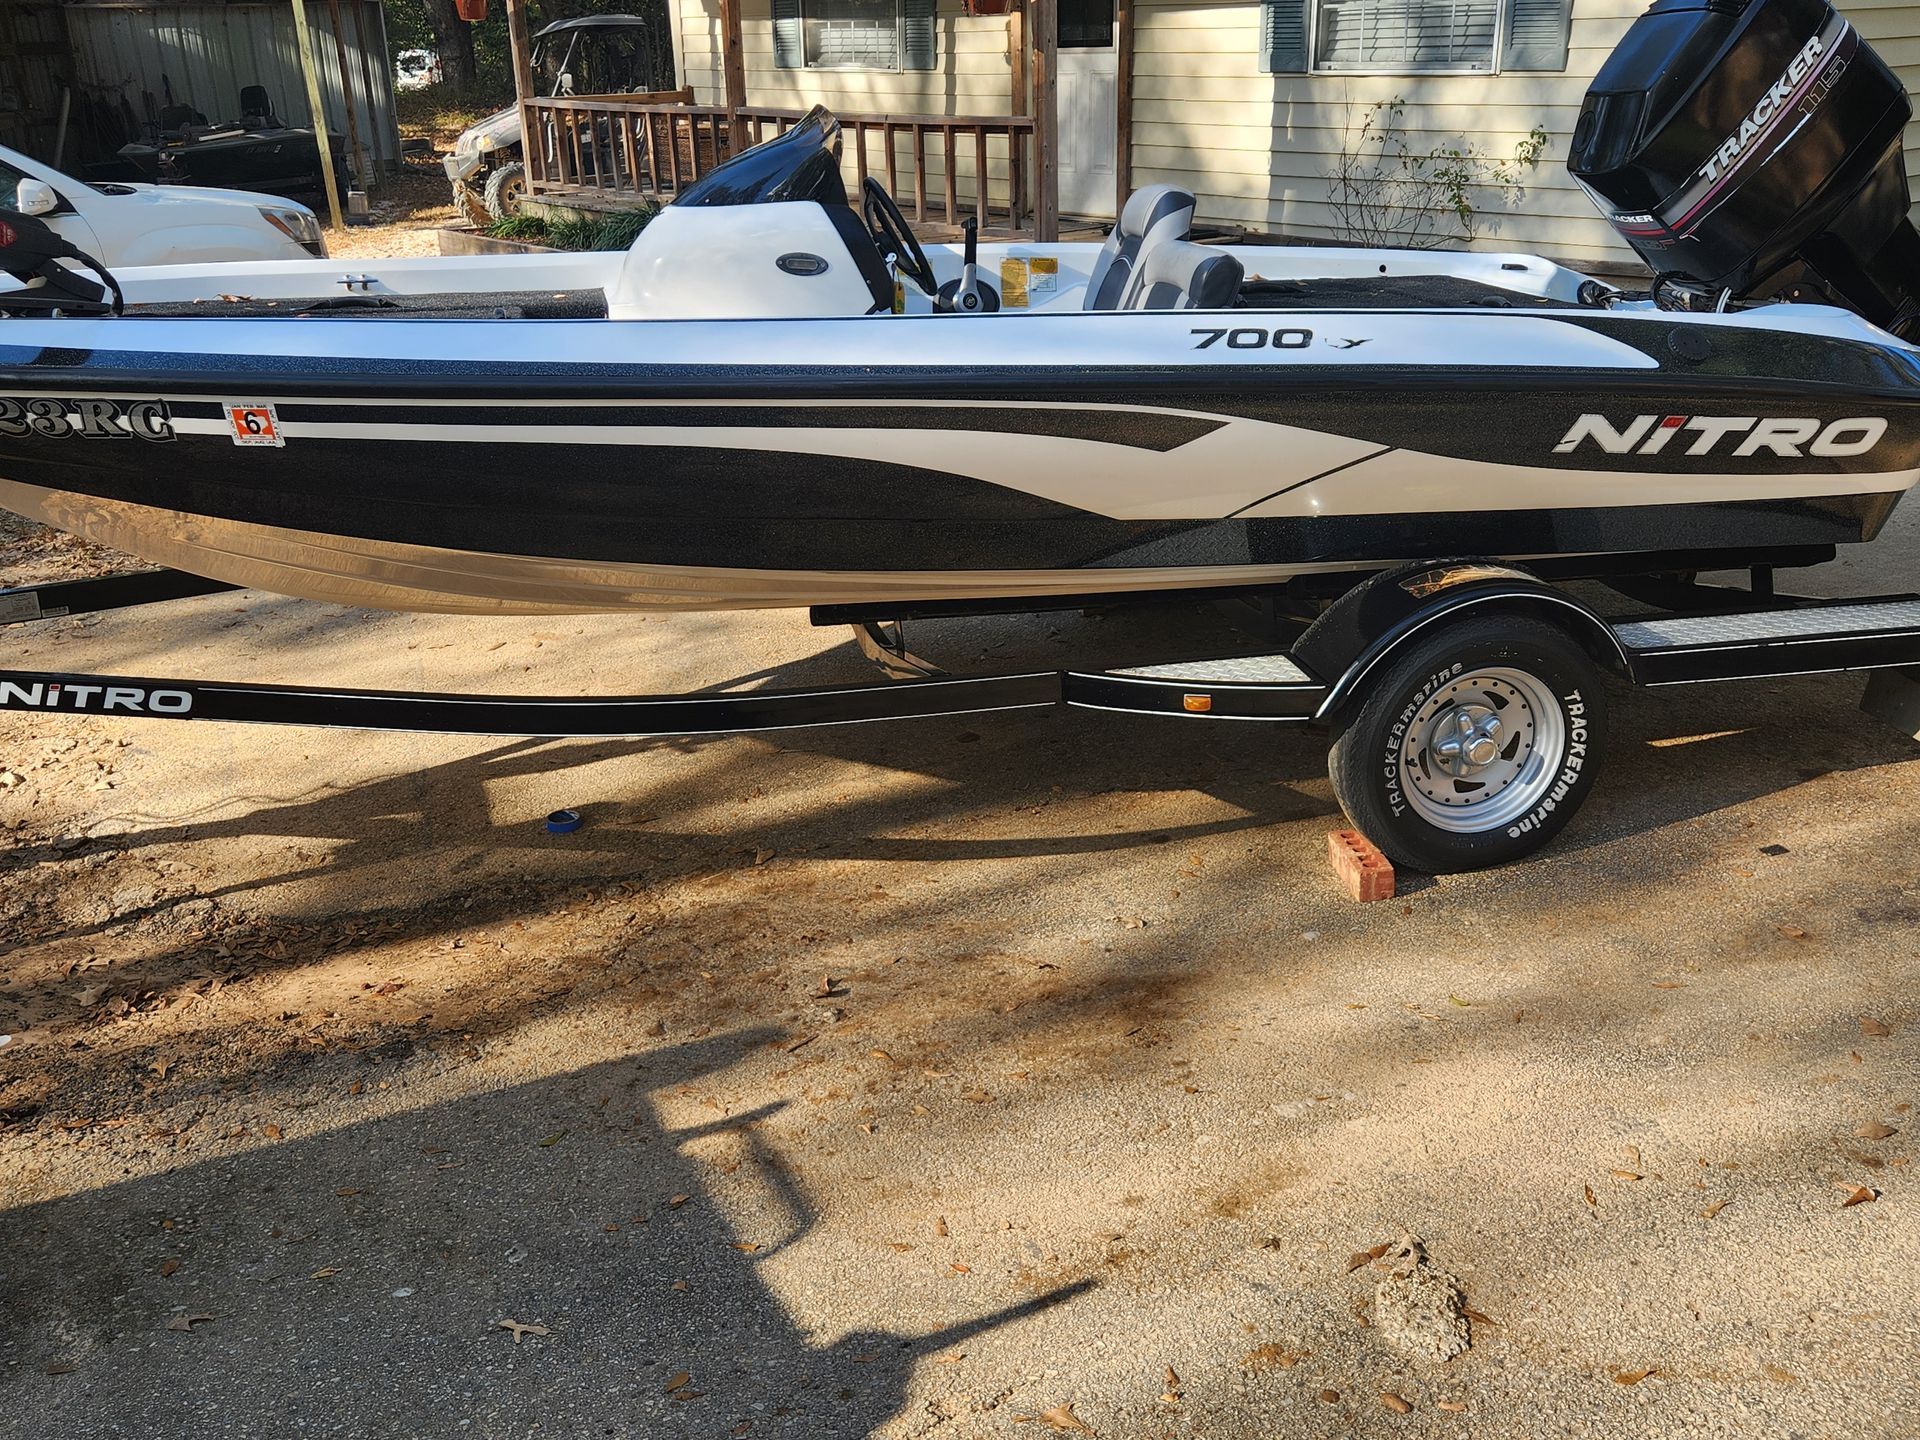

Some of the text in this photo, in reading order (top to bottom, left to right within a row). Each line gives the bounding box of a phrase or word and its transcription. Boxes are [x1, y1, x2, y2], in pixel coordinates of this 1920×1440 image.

[1797, 54, 1847, 117] 115
[1698, 35, 1824, 184] TRACKER
[1606, 213, 1654, 225] RACKER
[1190, 328, 1314, 350] 700
[244, 411, 261, 435] 6
